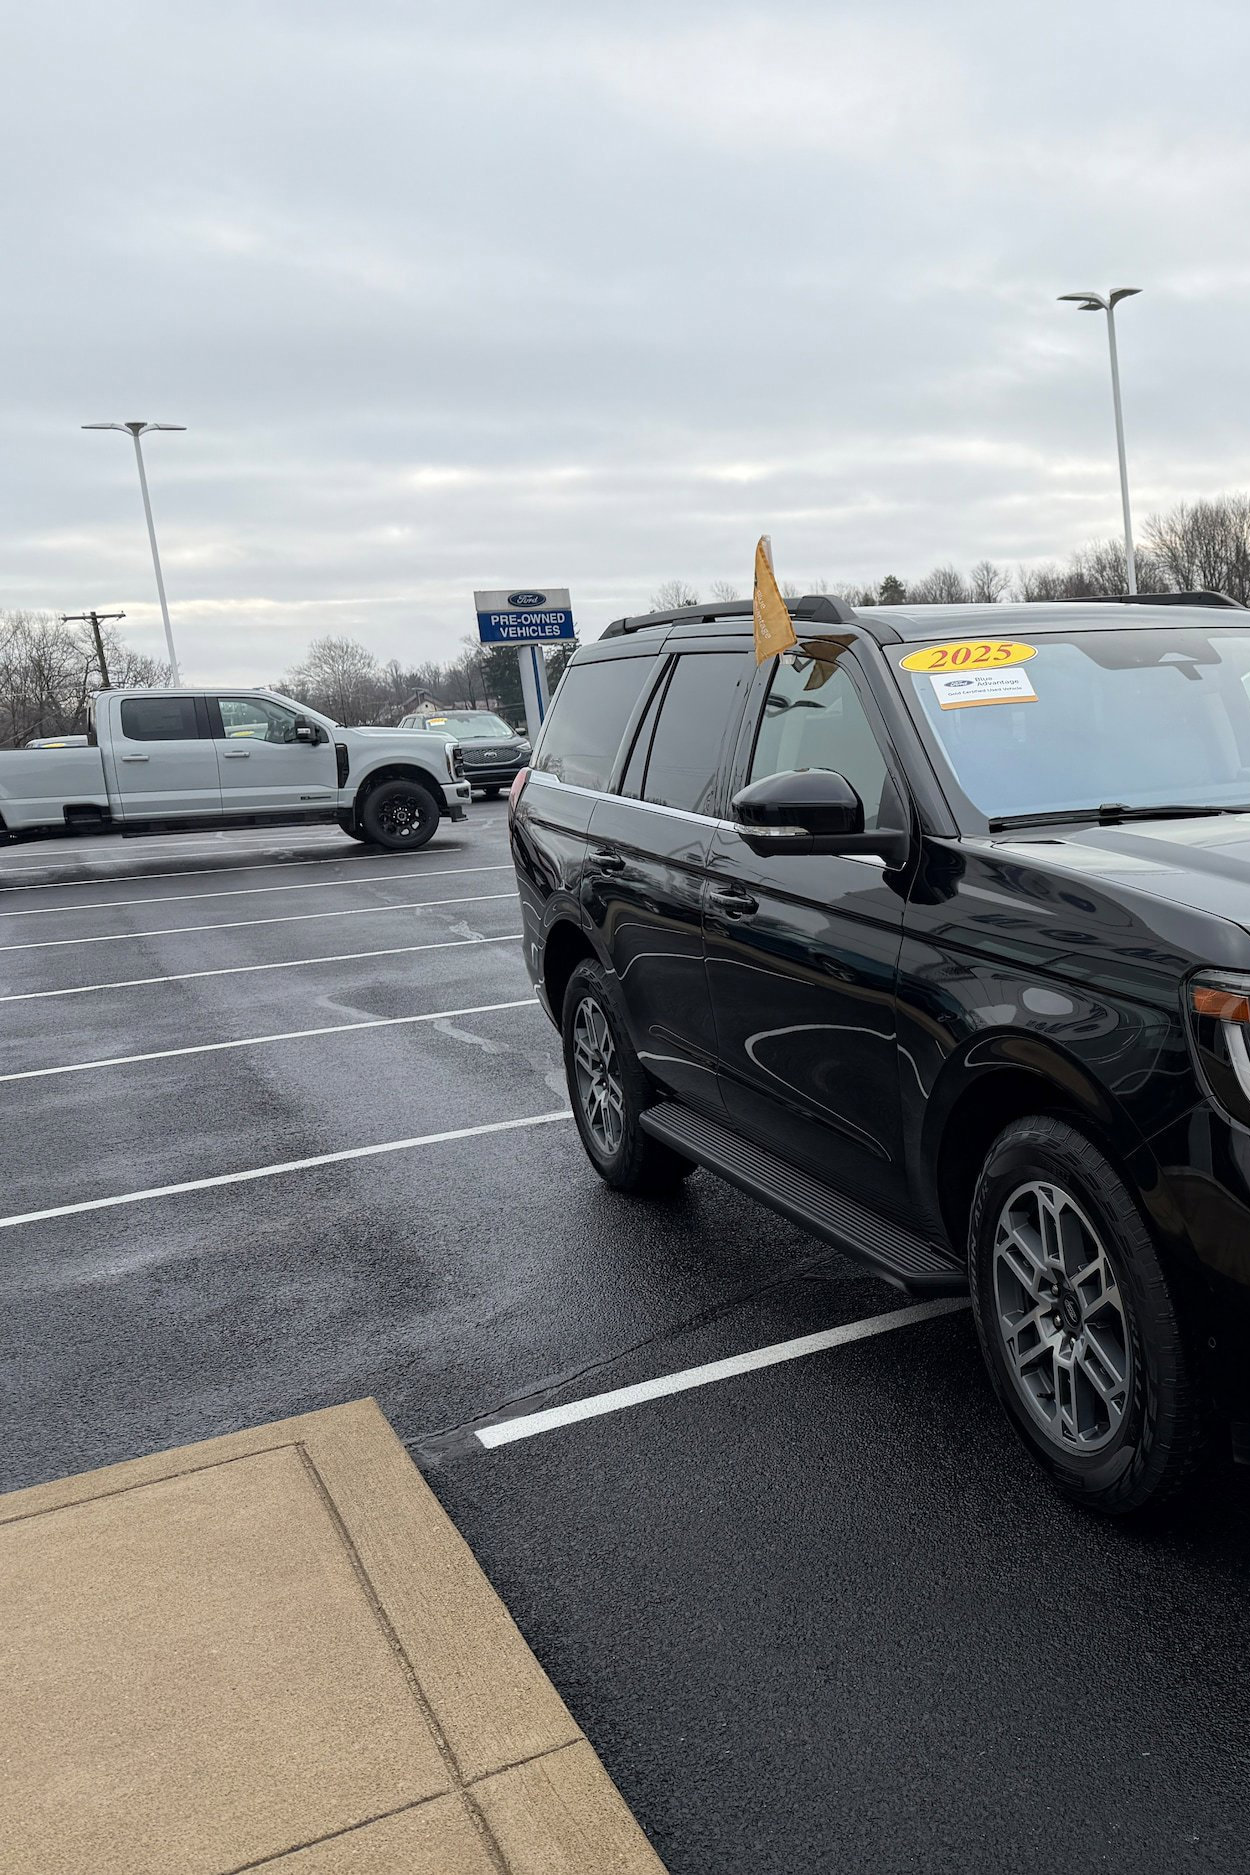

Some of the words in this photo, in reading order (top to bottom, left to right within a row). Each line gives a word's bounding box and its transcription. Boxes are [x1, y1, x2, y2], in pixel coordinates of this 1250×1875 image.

[491, 612, 565, 626] PRE-OWNED
[500, 625, 561, 638] VEHICLES
[928, 643, 1014, 669] 2025
[977, 679, 1020, 687] Advantage
